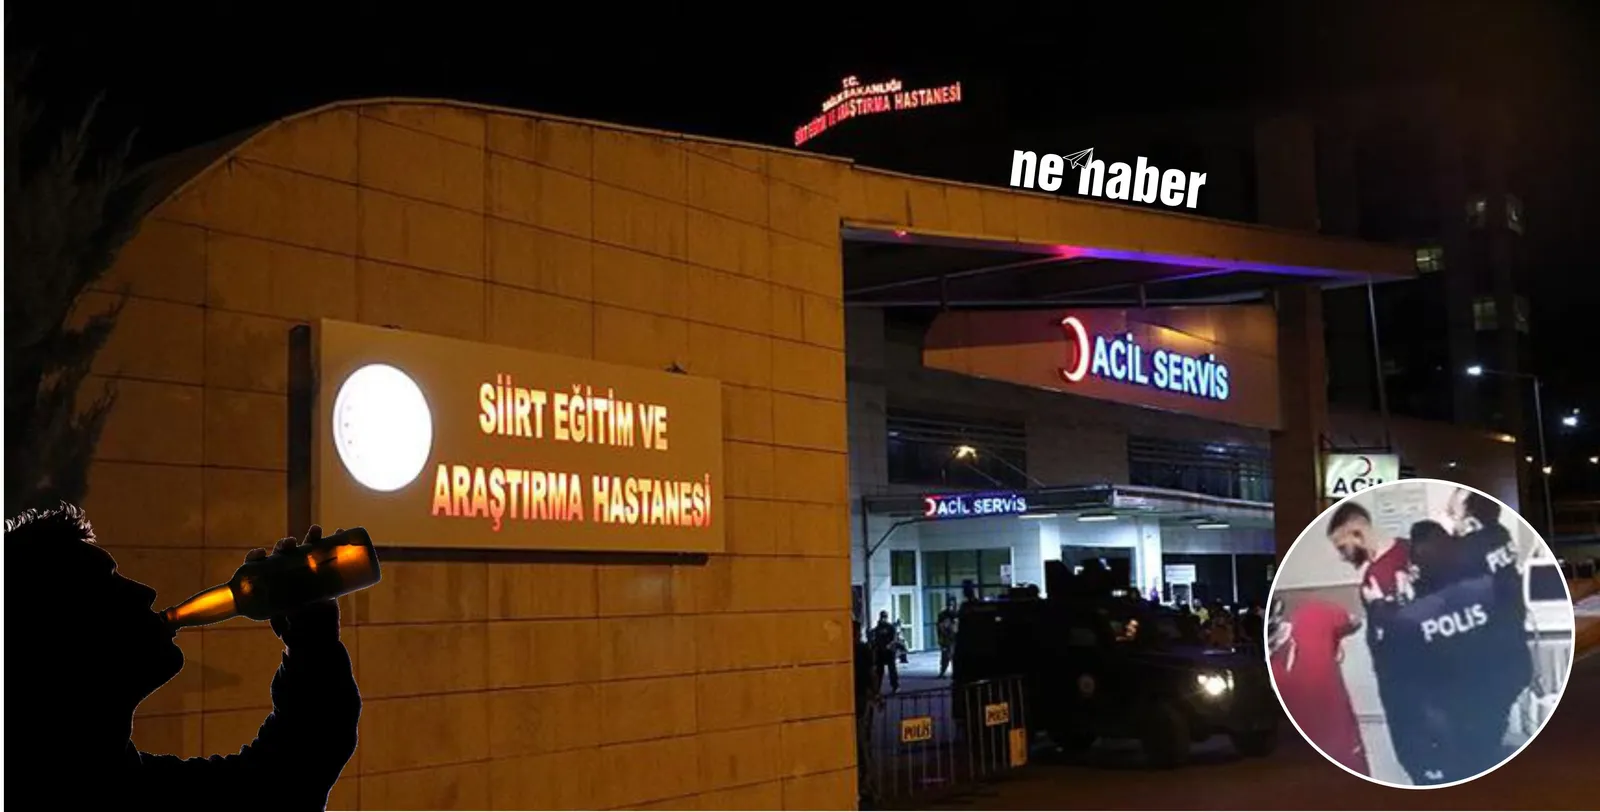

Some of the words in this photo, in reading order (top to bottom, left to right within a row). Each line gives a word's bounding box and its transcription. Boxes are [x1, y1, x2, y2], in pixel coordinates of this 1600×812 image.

[894, 81, 962, 110] HASTANESİ
[1091, 332, 1149, 385] ACİL
[1153, 354, 1230, 400] SERVİS
[479, 374, 547, 438] SİİRT
[554, 384, 634, 447] EĞİTİM
[638, 403, 668, 450] VE
[432, 464, 584, 532] ARAŞTIRMA
[592, 473, 711, 527] HASTANESİ
[974, 494, 1027, 513] SERVİS
